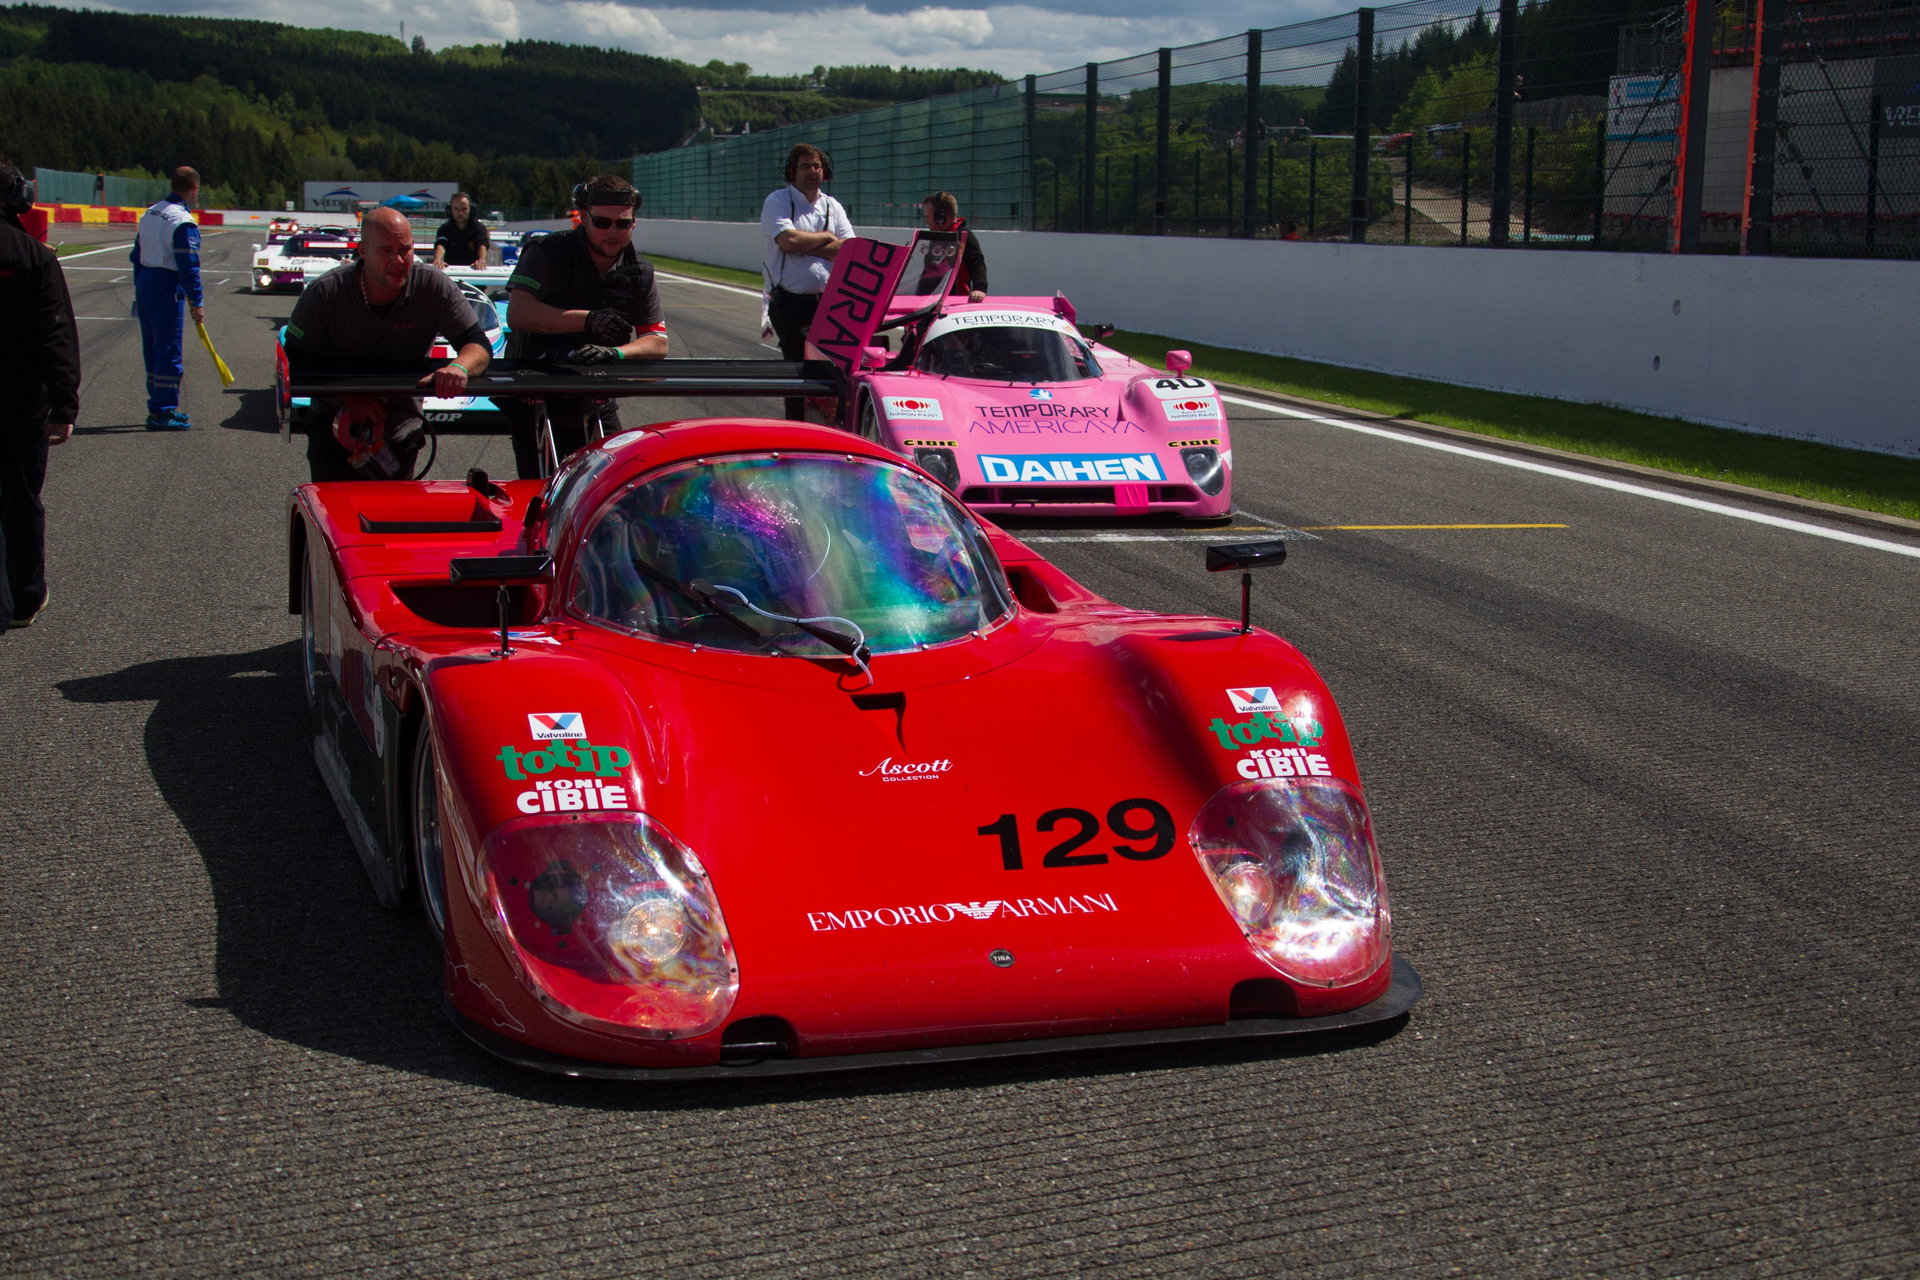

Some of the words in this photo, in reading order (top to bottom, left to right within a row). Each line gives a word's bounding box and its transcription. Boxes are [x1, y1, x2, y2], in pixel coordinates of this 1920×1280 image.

[952, 314, 1057, 327] TEMPORARY
[1155, 379, 1206, 391] 40
[424, 412, 463, 423] LOP
[975, 403, 1109, 419] TEMPORARY
[969, 420, 1146, 435] AMERICAYA
[981, 454, 1162, 482] DAIHEN
[1238, 704, 1279, 712] Valvoline
[536, 731, 583, 739] Valvoline
[1208, 711, 1324, 750] totip
[496, 739, 631, 780] totip
[1249, 748, 1308, 758] KONI
[858, 756, 954, 776] Ascott
[535, 779, 603, 791] KONI
[882, 774, 940, 782] COLLECTION
[976, 798, 1176, 871] 129
[807, 904, 955, 932] EMPORIO
[1001, 893, 1120, 919] ARMANI
